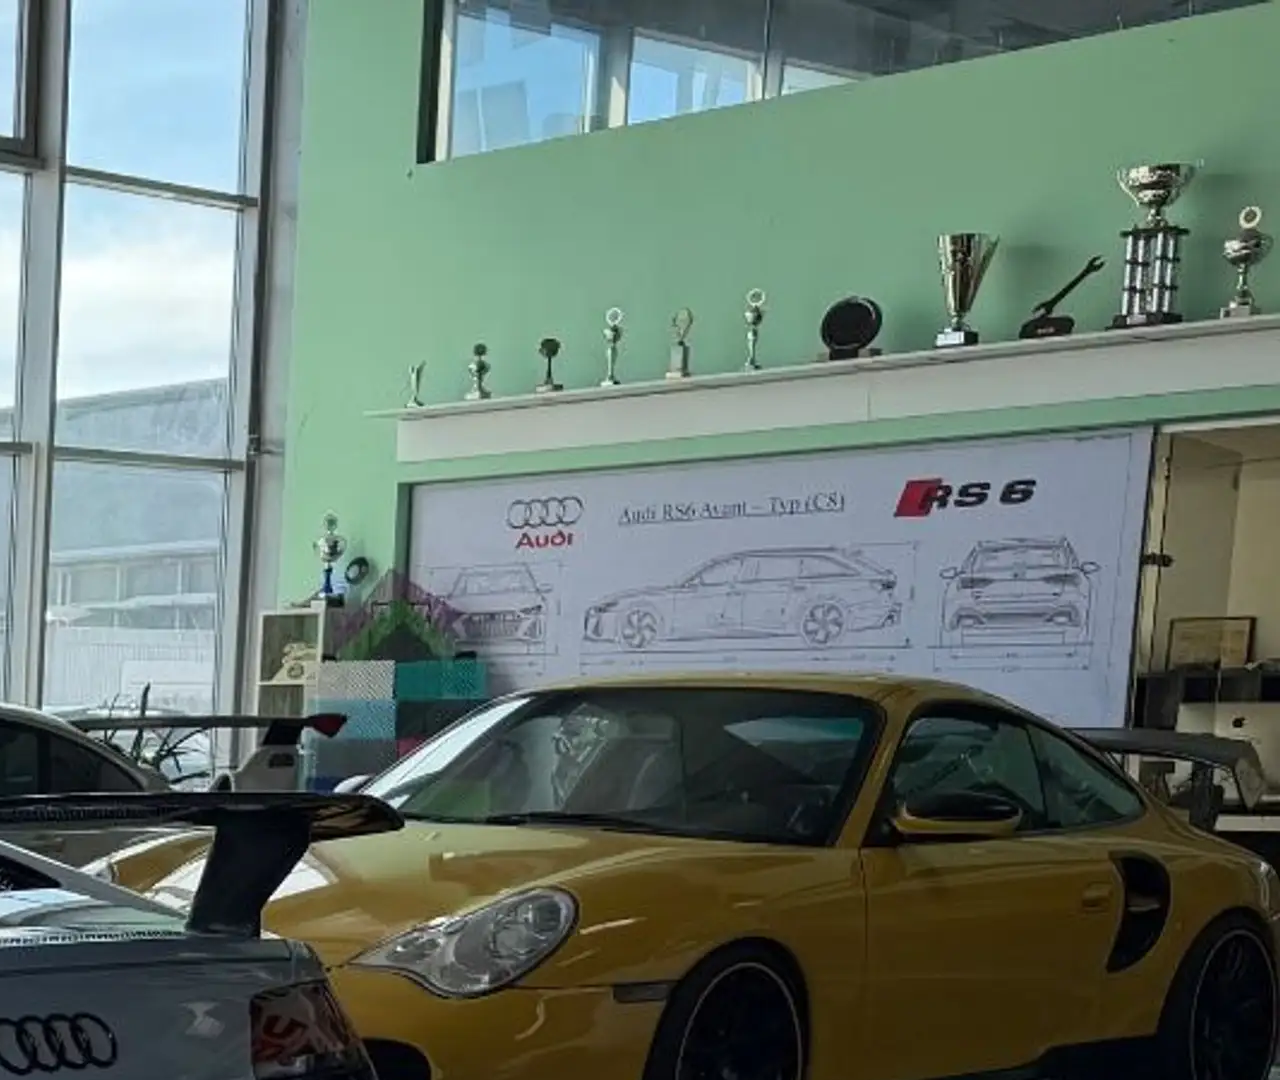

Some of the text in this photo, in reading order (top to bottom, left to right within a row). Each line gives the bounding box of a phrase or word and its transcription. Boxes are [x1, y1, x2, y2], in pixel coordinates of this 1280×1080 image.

[618, 505, 656, 524] Audi
[662, 503, 695, 520] RS6
[515, 530, 574, 549] Audi
